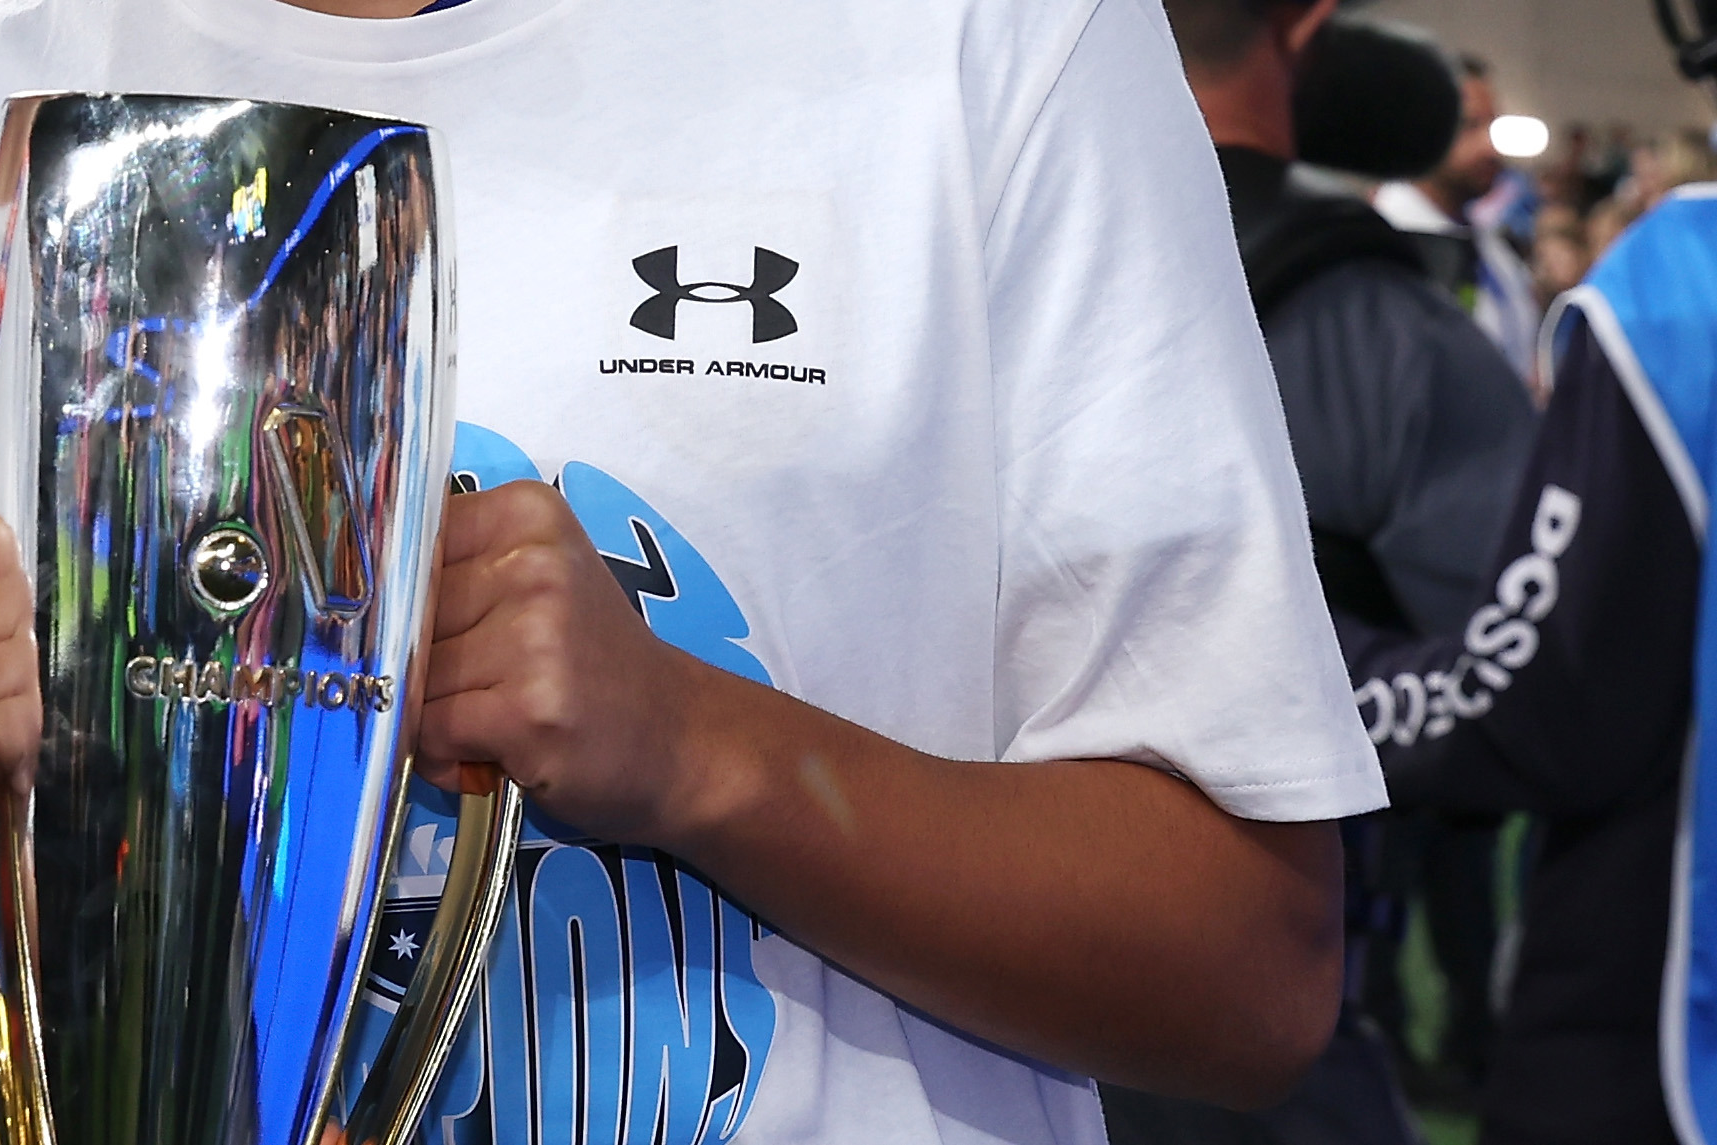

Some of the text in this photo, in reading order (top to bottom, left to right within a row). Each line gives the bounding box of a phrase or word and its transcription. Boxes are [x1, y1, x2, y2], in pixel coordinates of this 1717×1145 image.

[599, 358, 826, 385] UNDER ARMOUR
[125, 655, 394, 714] CHAMPIONS
